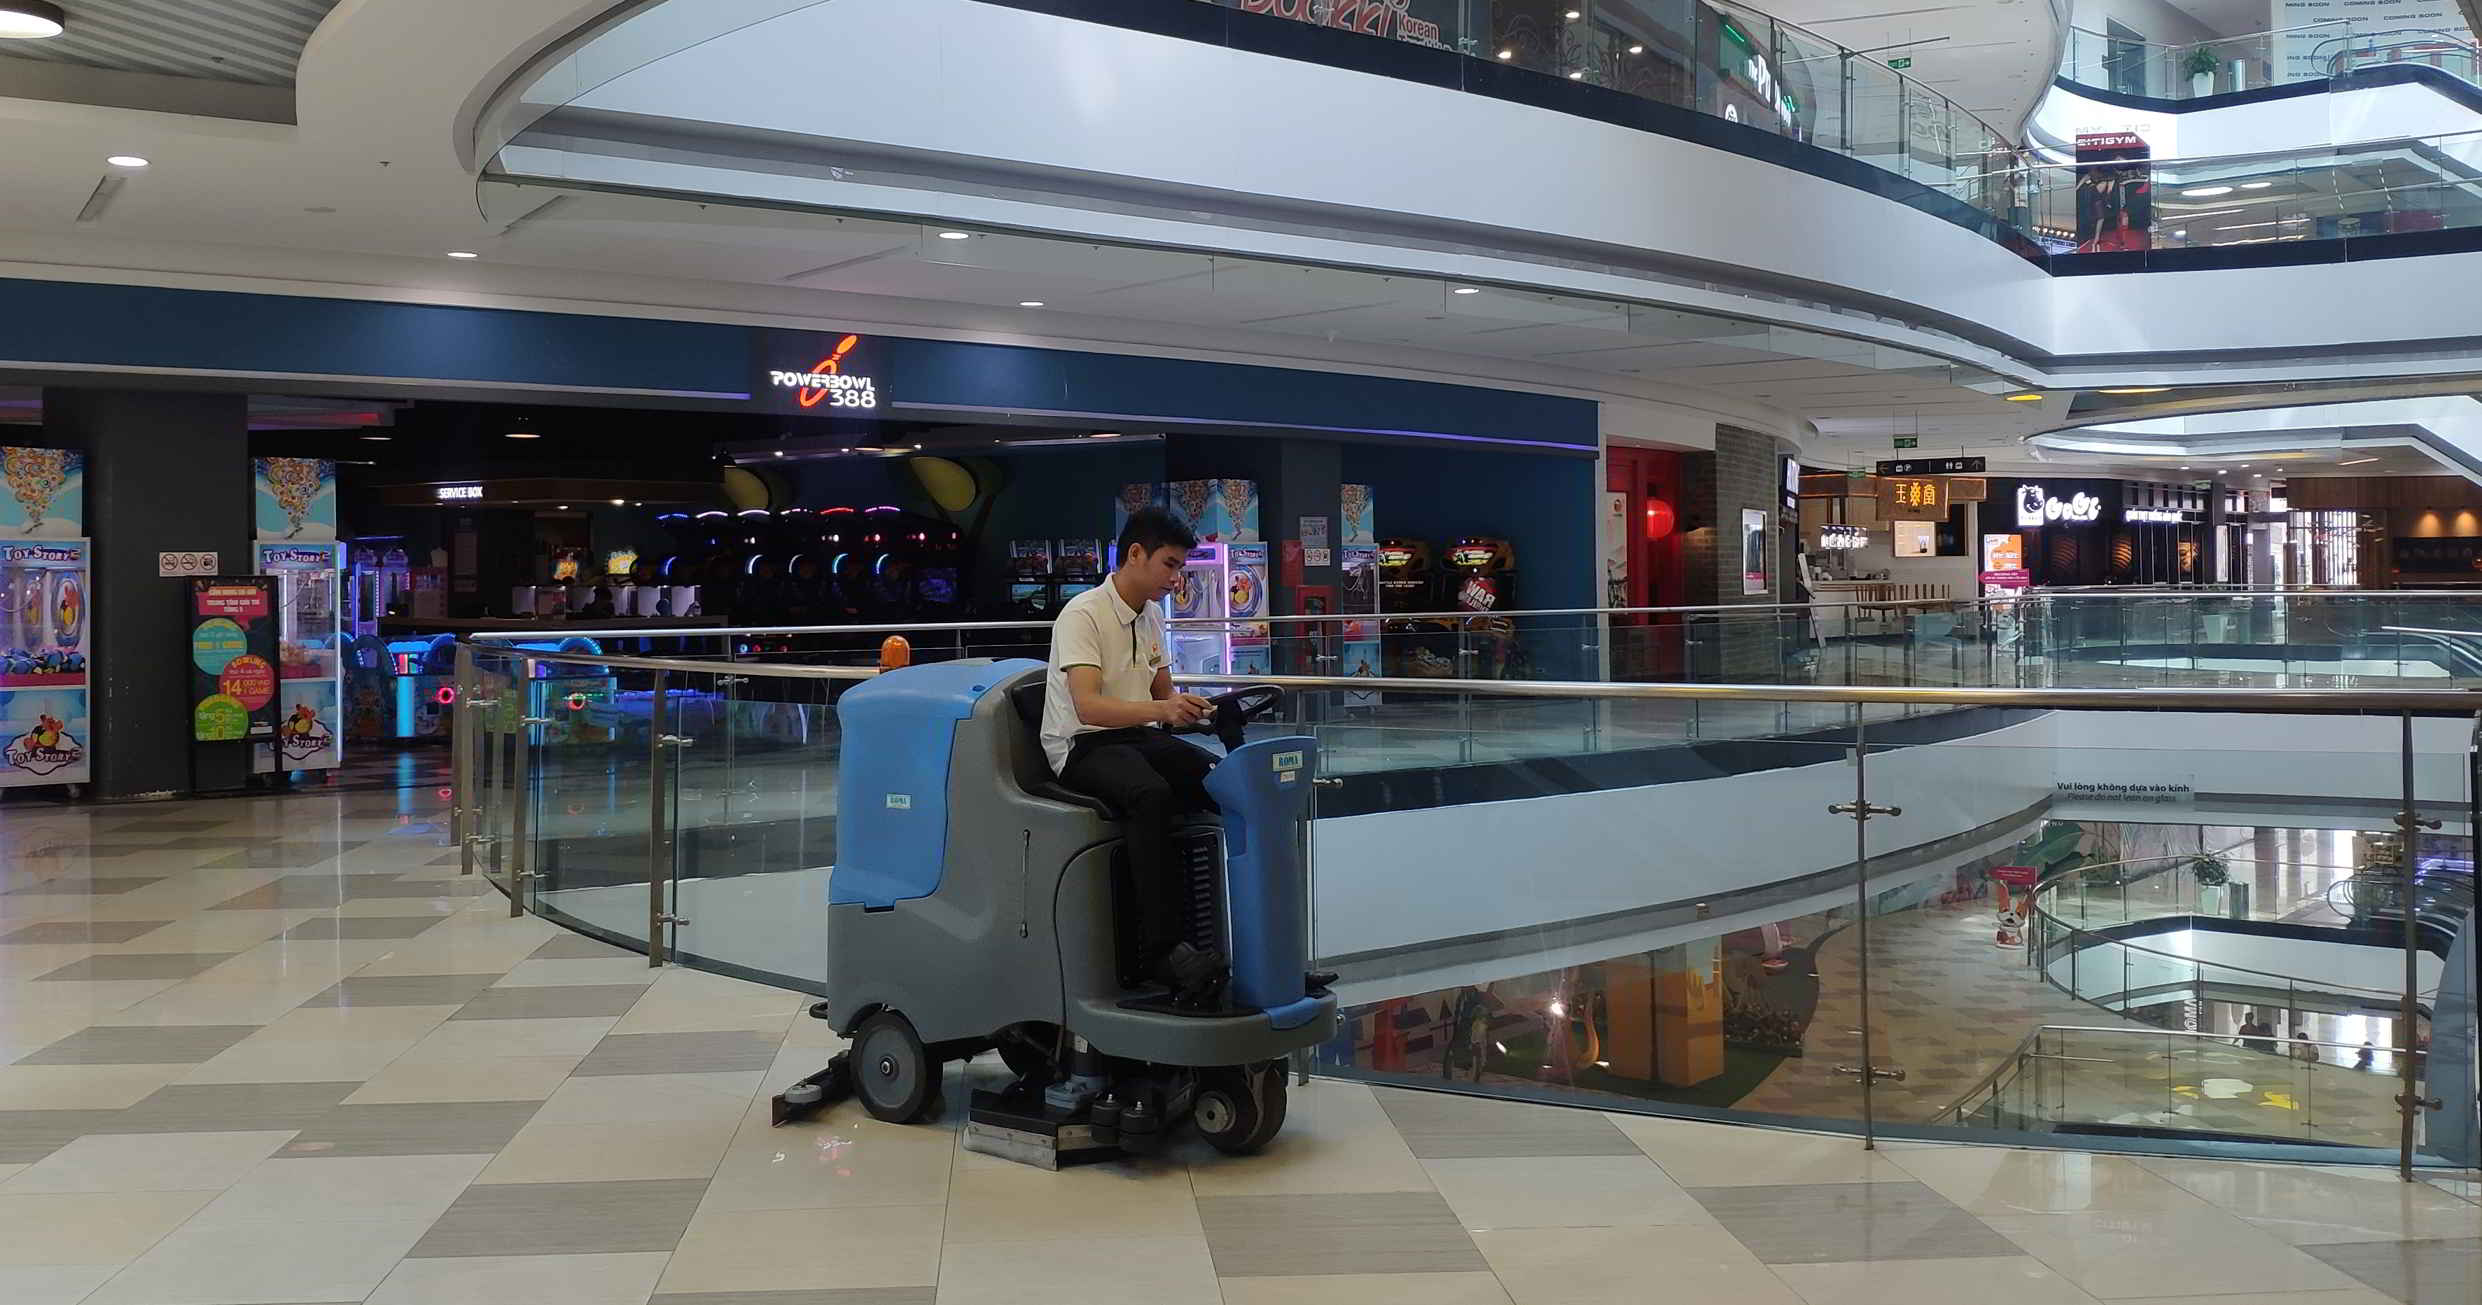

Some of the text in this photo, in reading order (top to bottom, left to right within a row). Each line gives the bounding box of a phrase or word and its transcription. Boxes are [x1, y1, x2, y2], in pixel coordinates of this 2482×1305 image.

[1399, 14, 1438, 40] Korean
[769, 370, 875, 392] POWERBOWL
[830, 388, 876, 408] 388
[437, 486, 483, 499] SERVICE BOX
[223, 679, 242, 696] 14
[1279, 754, 1299, 766] ROMA
[2056, 782, 2073, 791] Vui
